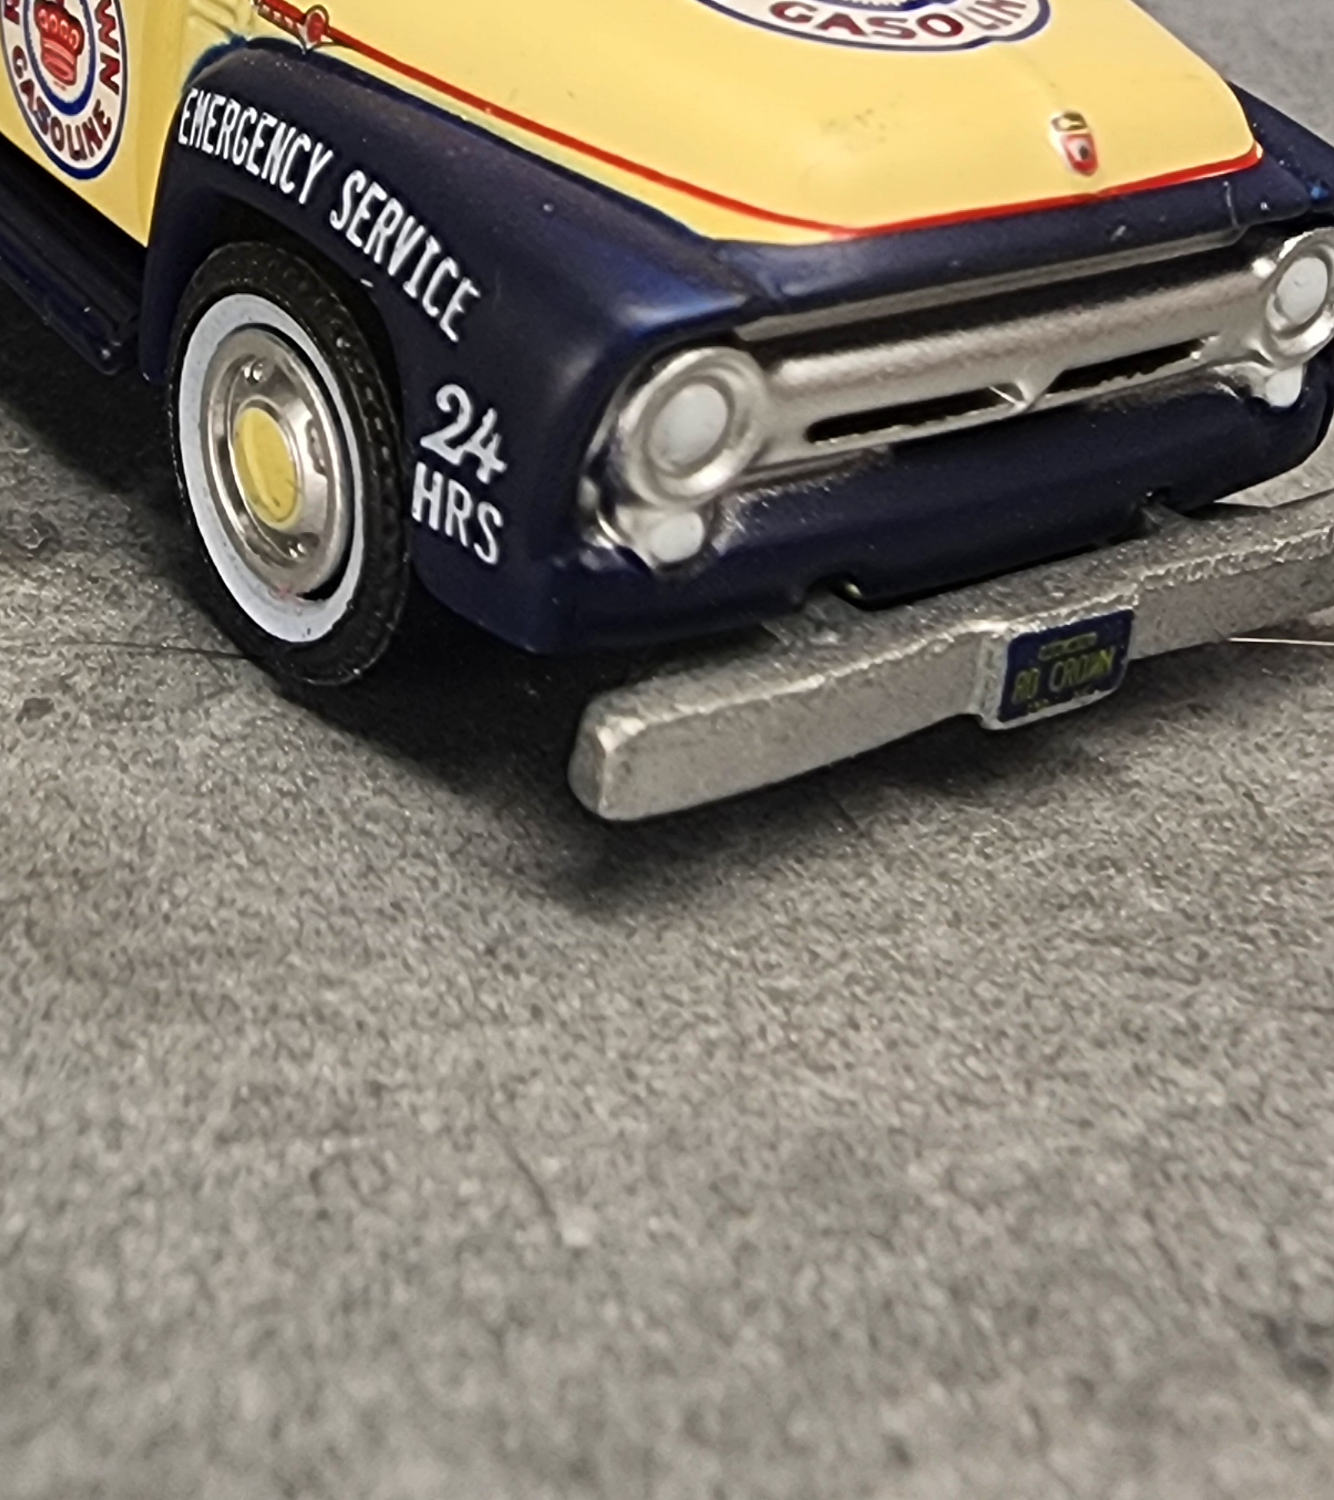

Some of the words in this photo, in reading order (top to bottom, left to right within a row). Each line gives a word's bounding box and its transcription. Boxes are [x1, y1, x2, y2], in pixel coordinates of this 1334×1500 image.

[12, 44, 112, 161] GASOLINE
[176, 87, 334, 205] EMERGENCY
[329, 169, 481, 343] SERVICE
[420, 384, 507, 485] 24
[412, 461, 505, 566] HRS
